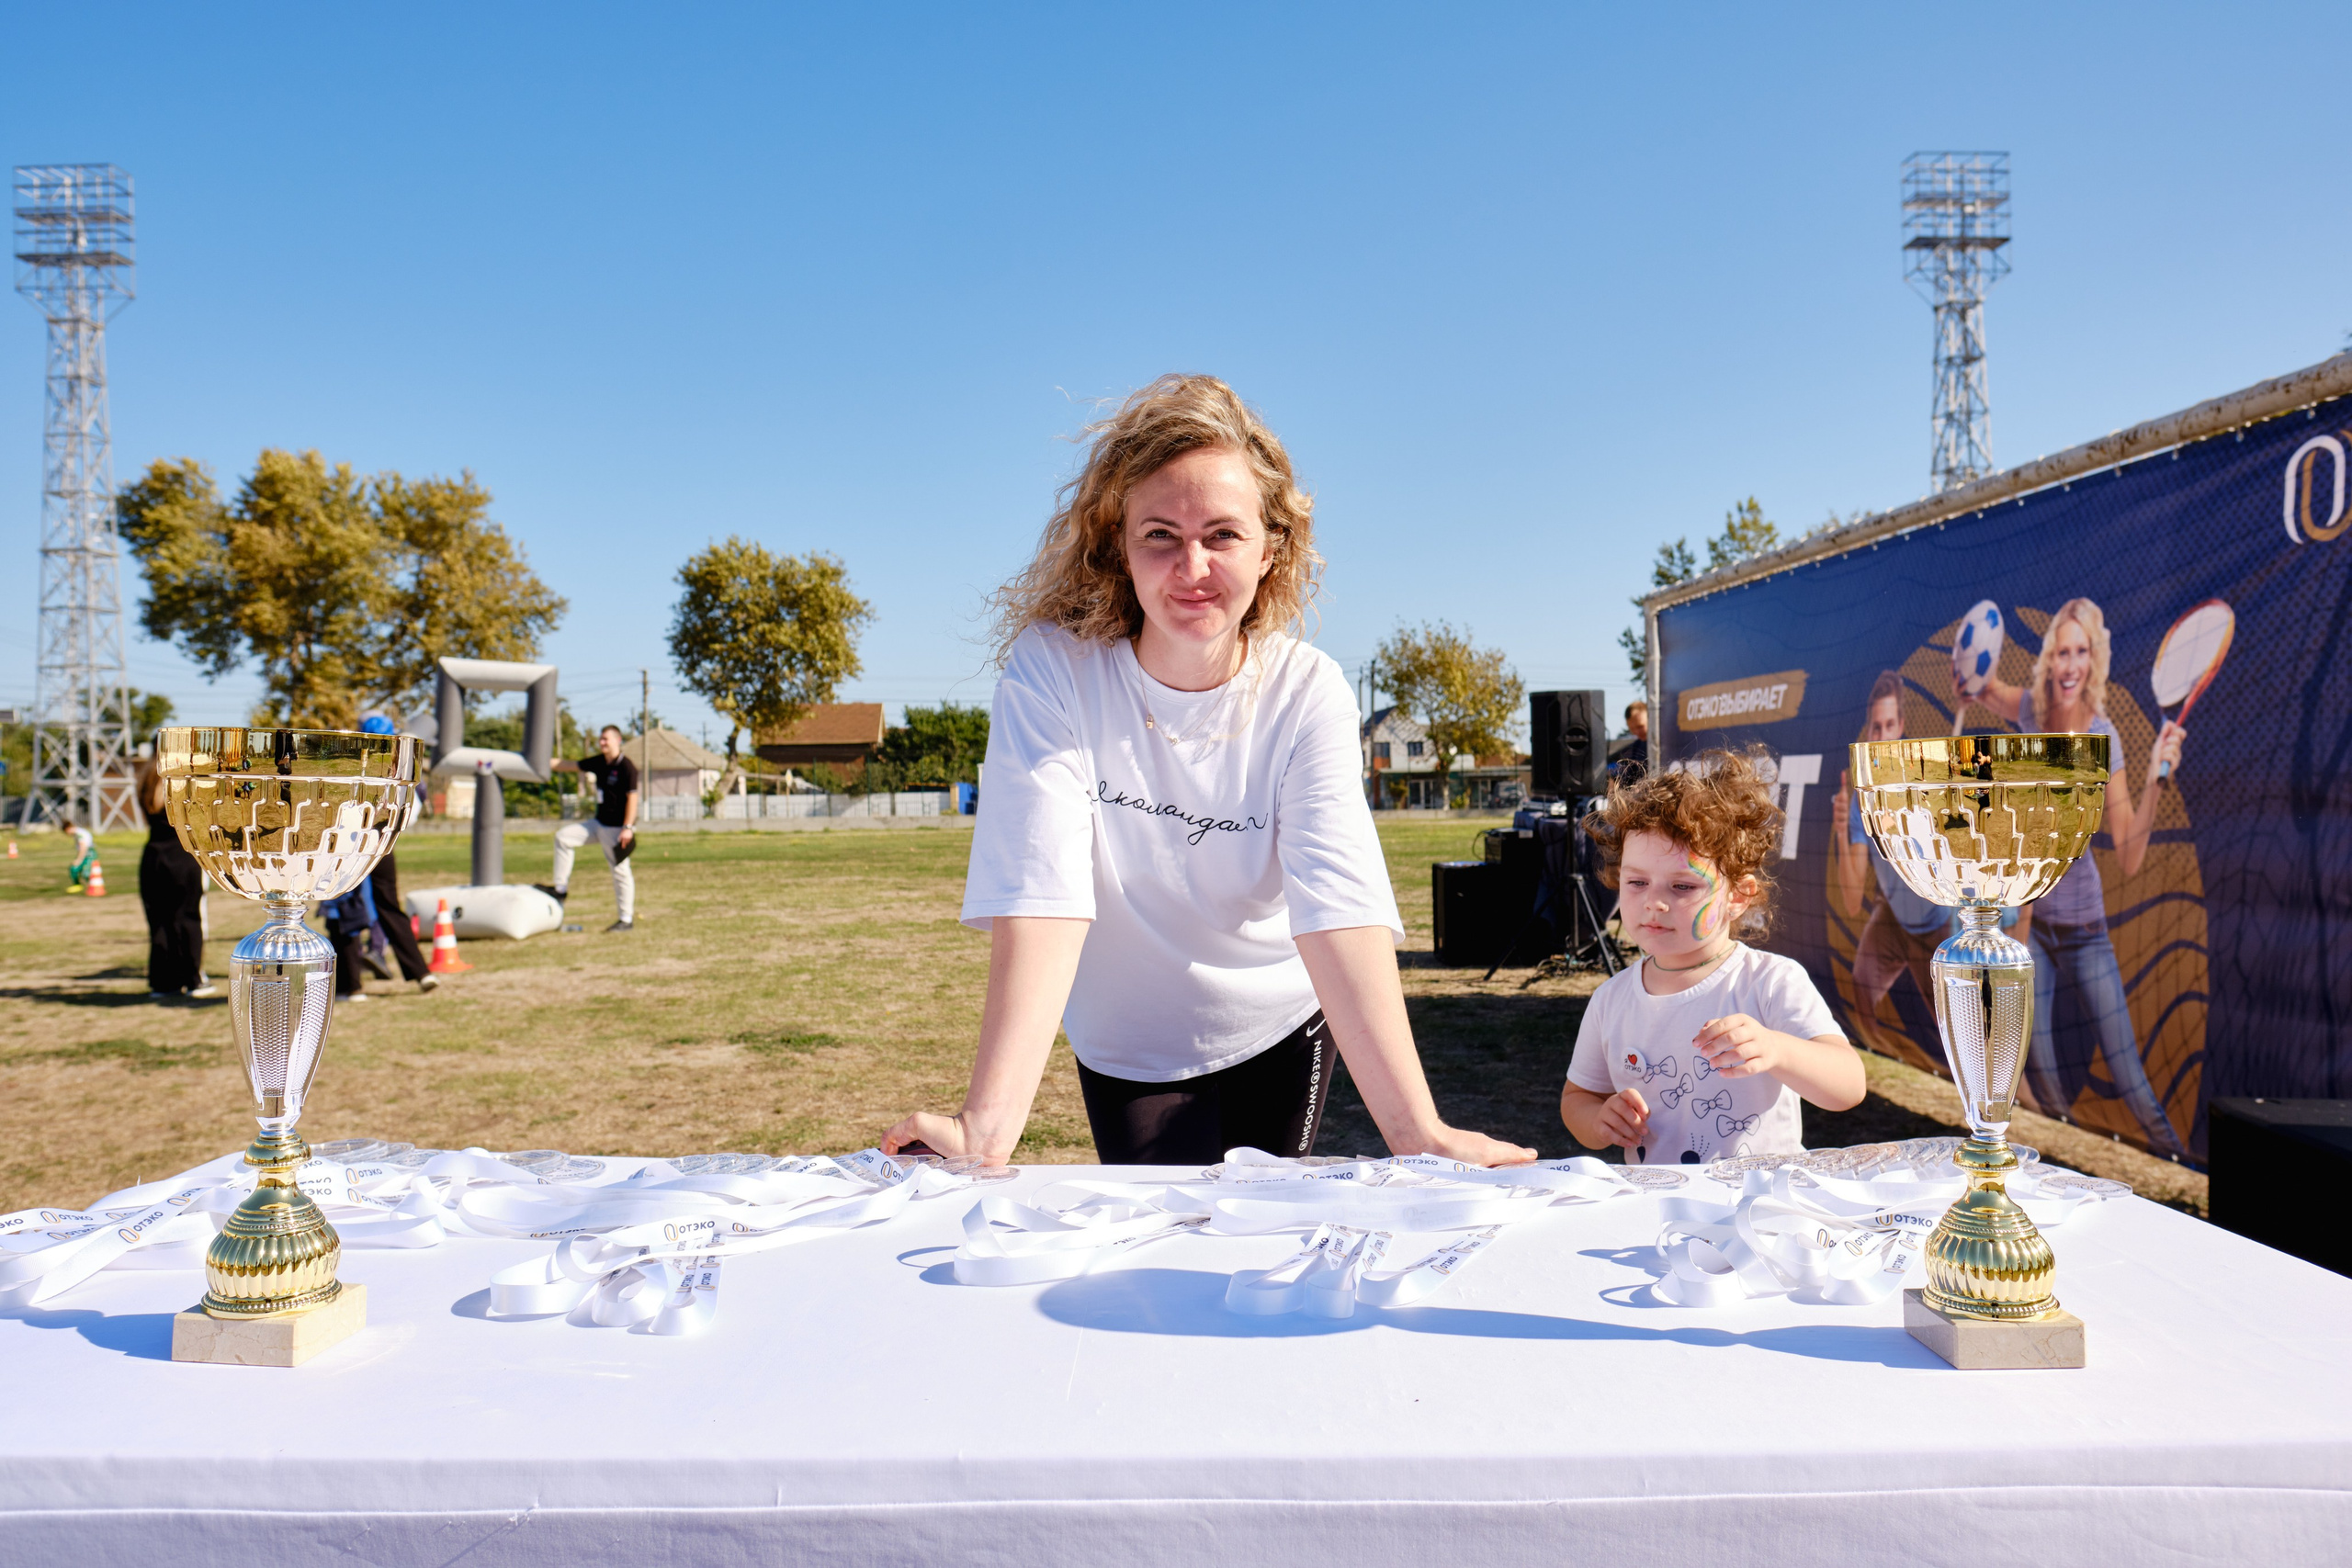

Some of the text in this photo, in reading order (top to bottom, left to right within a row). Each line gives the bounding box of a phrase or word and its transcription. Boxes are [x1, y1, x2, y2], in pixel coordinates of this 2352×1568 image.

[1718, 683, 1788, 716] ВЫБИРАЕТ
[1624, 1064, 1642, 1074] ОТЭКО
[303, 1159, 322, 1169] ЭКО
[1404, 1158, 1439, 1167] ОТЭКО
[358, 1168, 383, 1179] ОТЭКО
[58, 1213, 94, 1222] ОТЭКО
[133, 1211, 164, 1232] ОТЭКО
[1894, 1213, 1934, 1228] ОТЭКО
[679, 1220, 716, 1235] ОТЭКО
[1854, 1231, 1874, 1247] ОТЭКО
[1440, 1256, 1459, 1269] ОТЭКО
[1892, 1254, 1907, 1269] ОТЭКО
[701, 1272, 713, 1286] ОТЭКО
